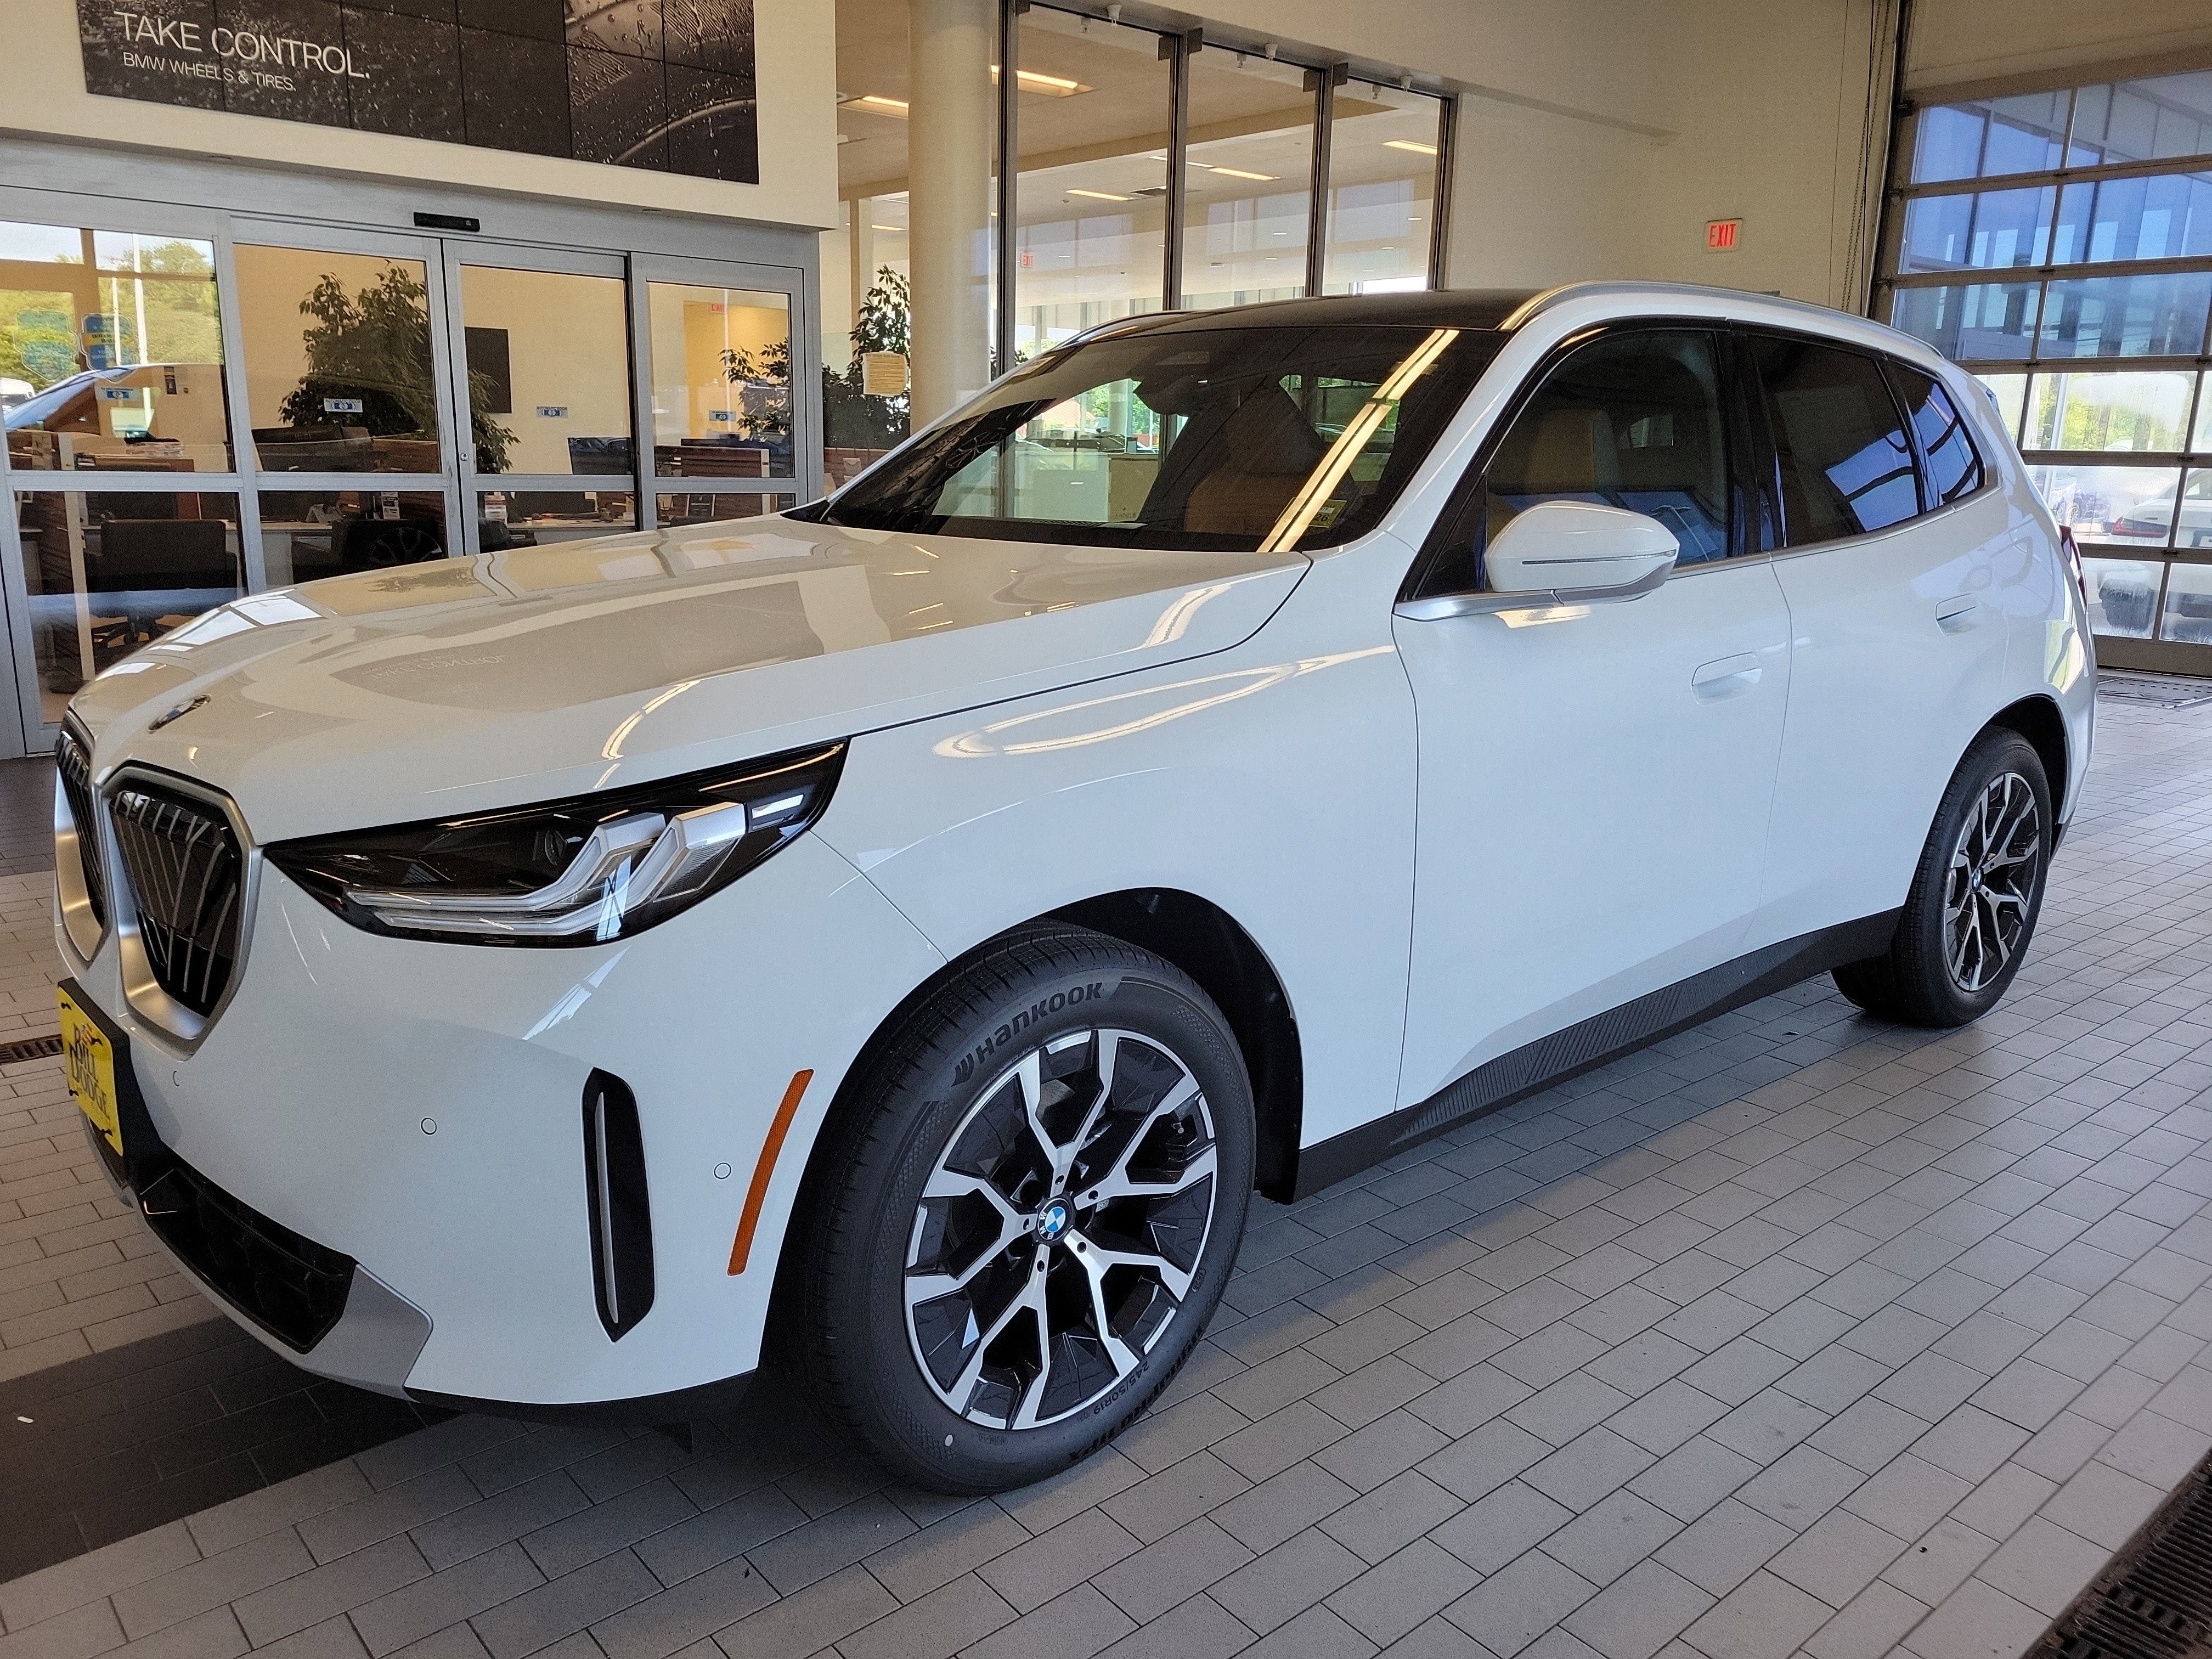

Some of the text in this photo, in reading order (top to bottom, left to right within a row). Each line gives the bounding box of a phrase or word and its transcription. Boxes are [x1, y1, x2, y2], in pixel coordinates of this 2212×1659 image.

[114, 10, 370, 80] TAKE CONTROL.
[123, 52, 297, 92] BMW WHEELS & TIRES.
[1709, 223, 1736, 247] EXIT
[1093, 1360, 1150, 1415] 245/50R19
